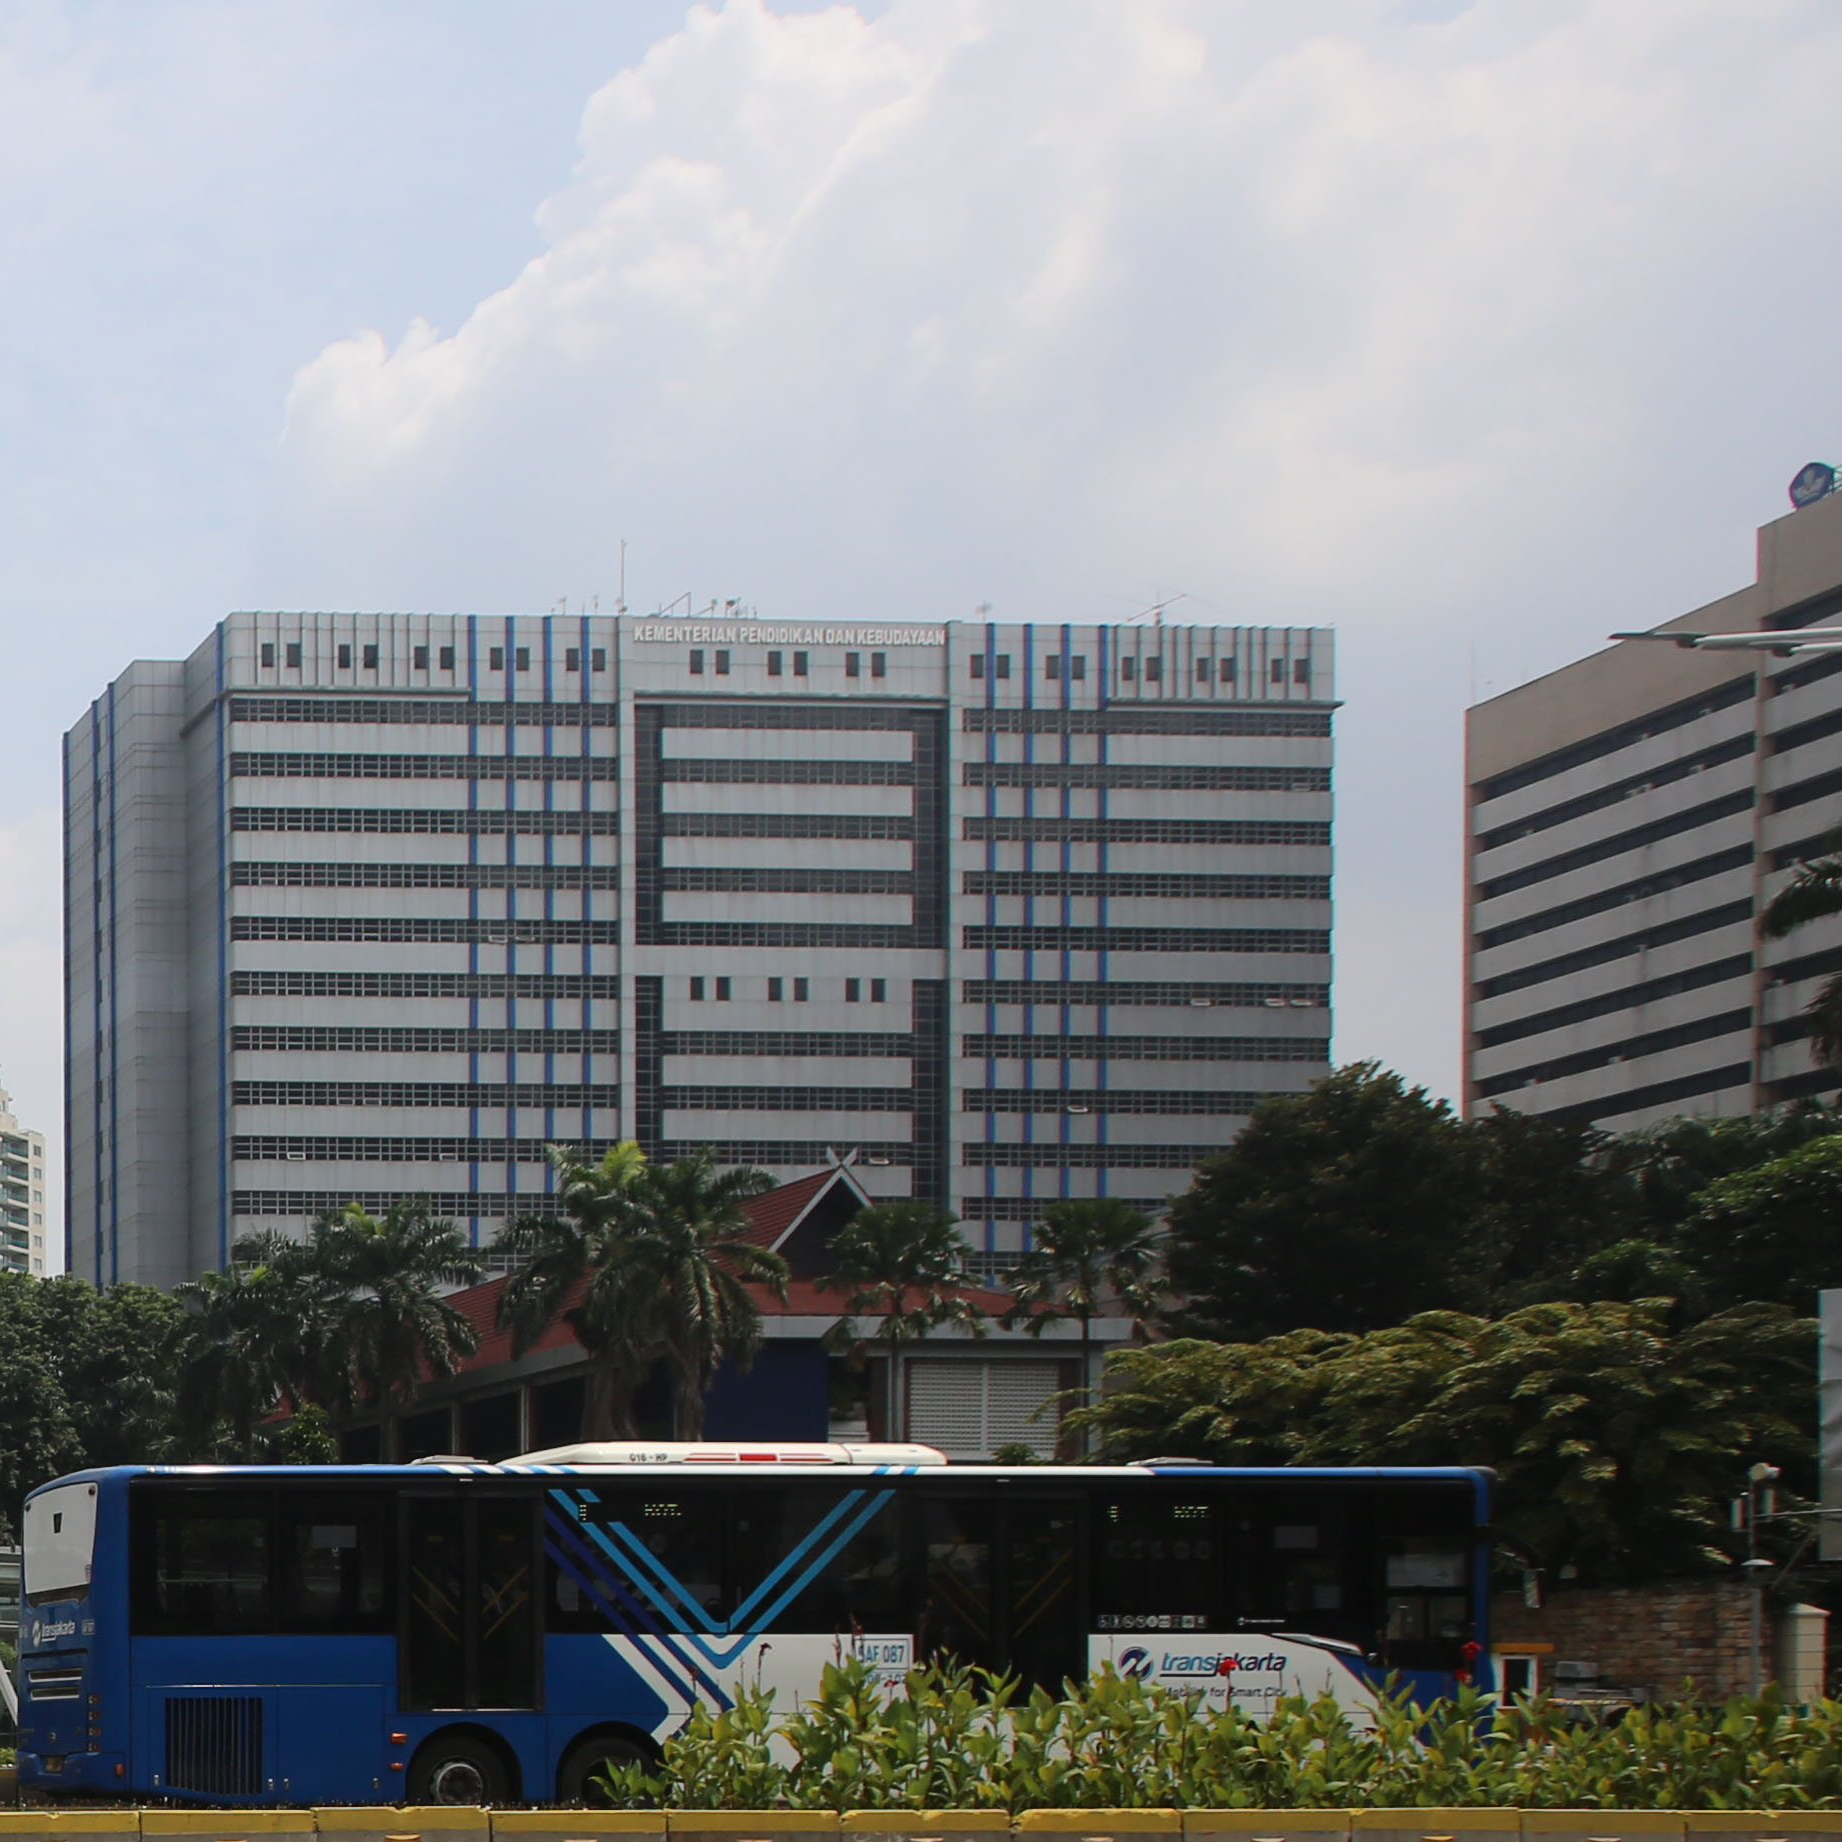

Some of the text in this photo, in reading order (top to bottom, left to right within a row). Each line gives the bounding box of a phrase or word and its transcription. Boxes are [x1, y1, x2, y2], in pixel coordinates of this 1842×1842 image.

[634, 625, 946, 646] KEMENTERIAN PENDIDIKAN DAN KEBUDAYAAN
[1161, 1651, 1288, 1677] transjkarta
[1210, 1686, 1226, 1697] for
